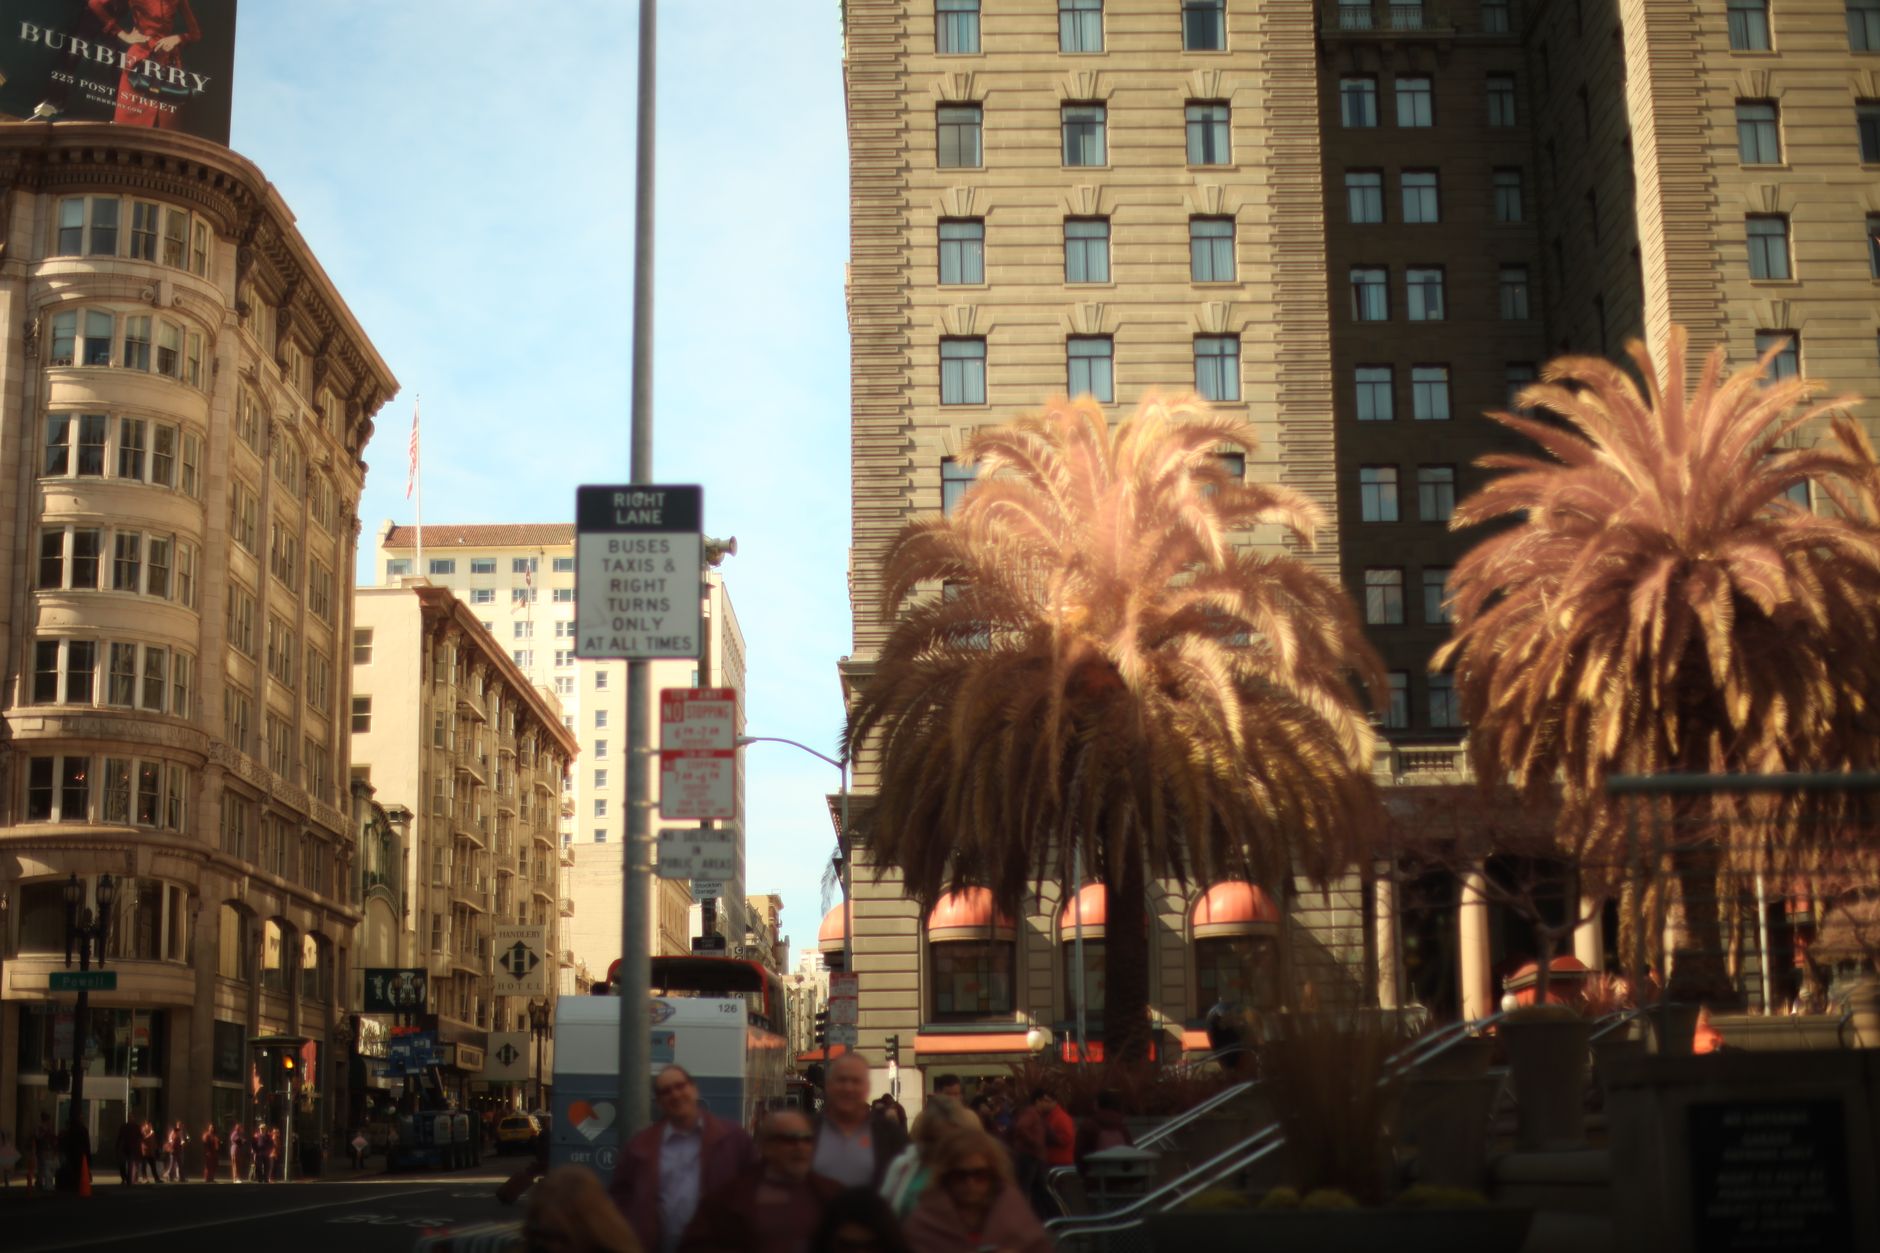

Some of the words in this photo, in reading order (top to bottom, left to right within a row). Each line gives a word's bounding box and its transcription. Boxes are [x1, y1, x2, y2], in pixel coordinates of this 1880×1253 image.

[20, 21, 212, 93] BURBERRY
[51, 70, 74, 85] 225
[80, 79, 116, 96] POST
[121, 91, 178, 114] STREET
[613, 493, 666, 507] RIGHT
[616, 510, 663, 525] LANE
[608, 539, 670, 553] BUSES
[602, 559, 655, 573] TAXIS
[664, 559, 676, 573] &
[610, 579, 667, 593] RIGHT
[607, 598, 671, 612] TURNS
[612, 617, 664, 631] ONLY
[585, 637, 603, 650] AT
[610, 637, 637, 650] ALL
[646, 637, 692, 650] TIMES
[664, 701, 683, 721] NO
[686, 704, 729, 720] STOPPING
[702, 858, 732, 869] AREAS
[499, 930, 541, 939] HANDLERY
[63, 976, 104, 986] Powell
[719, 1004, 737, 1013] 126
[571, 1152, 592, 1162] GET
